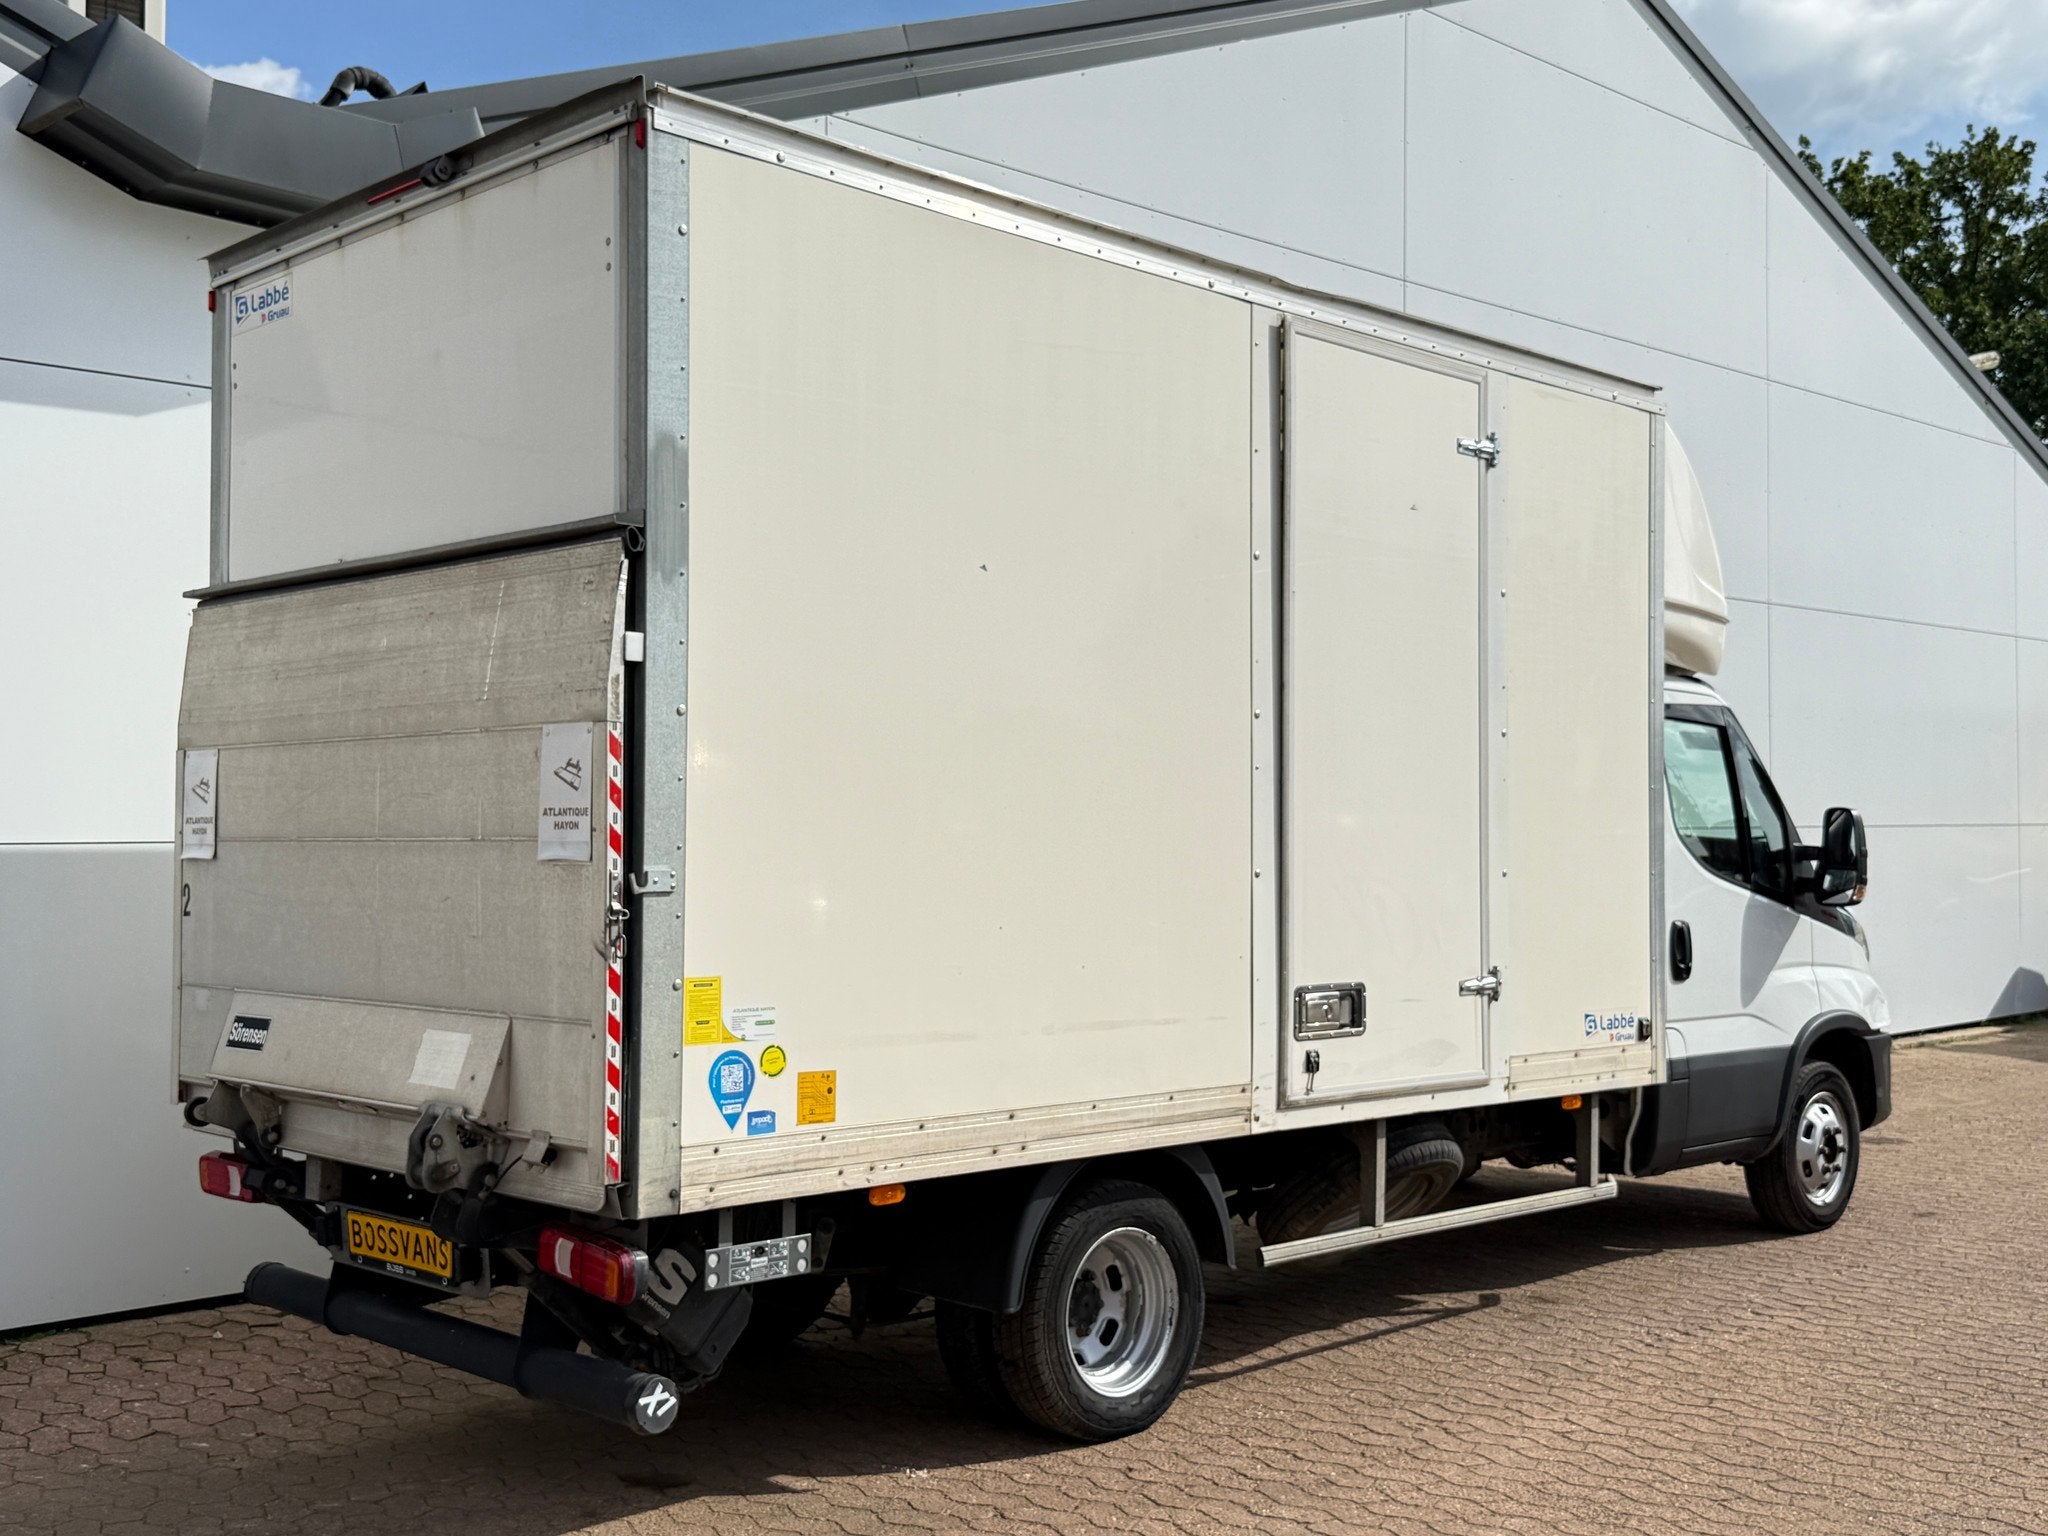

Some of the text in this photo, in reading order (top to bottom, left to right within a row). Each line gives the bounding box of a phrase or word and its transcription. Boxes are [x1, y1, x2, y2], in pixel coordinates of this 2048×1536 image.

[251, 280, 290, 313] Labbé
[267, 306, 290, 322] Gruau
[185, 816, 214, 825] ATLANTIQUE
[542, 807, 590, 817] ATLANTIQUE
[553, 820, 580, 831] HAYON
[183, 882, 192, 917] 2
[1599, 1012, 1635, 1031] Labbé
[229, 1021, 269, 1045] Sörensen
[351, 1218, 449, 1271] BOSSVANS
[638, 1381, 678, 1417] X1
